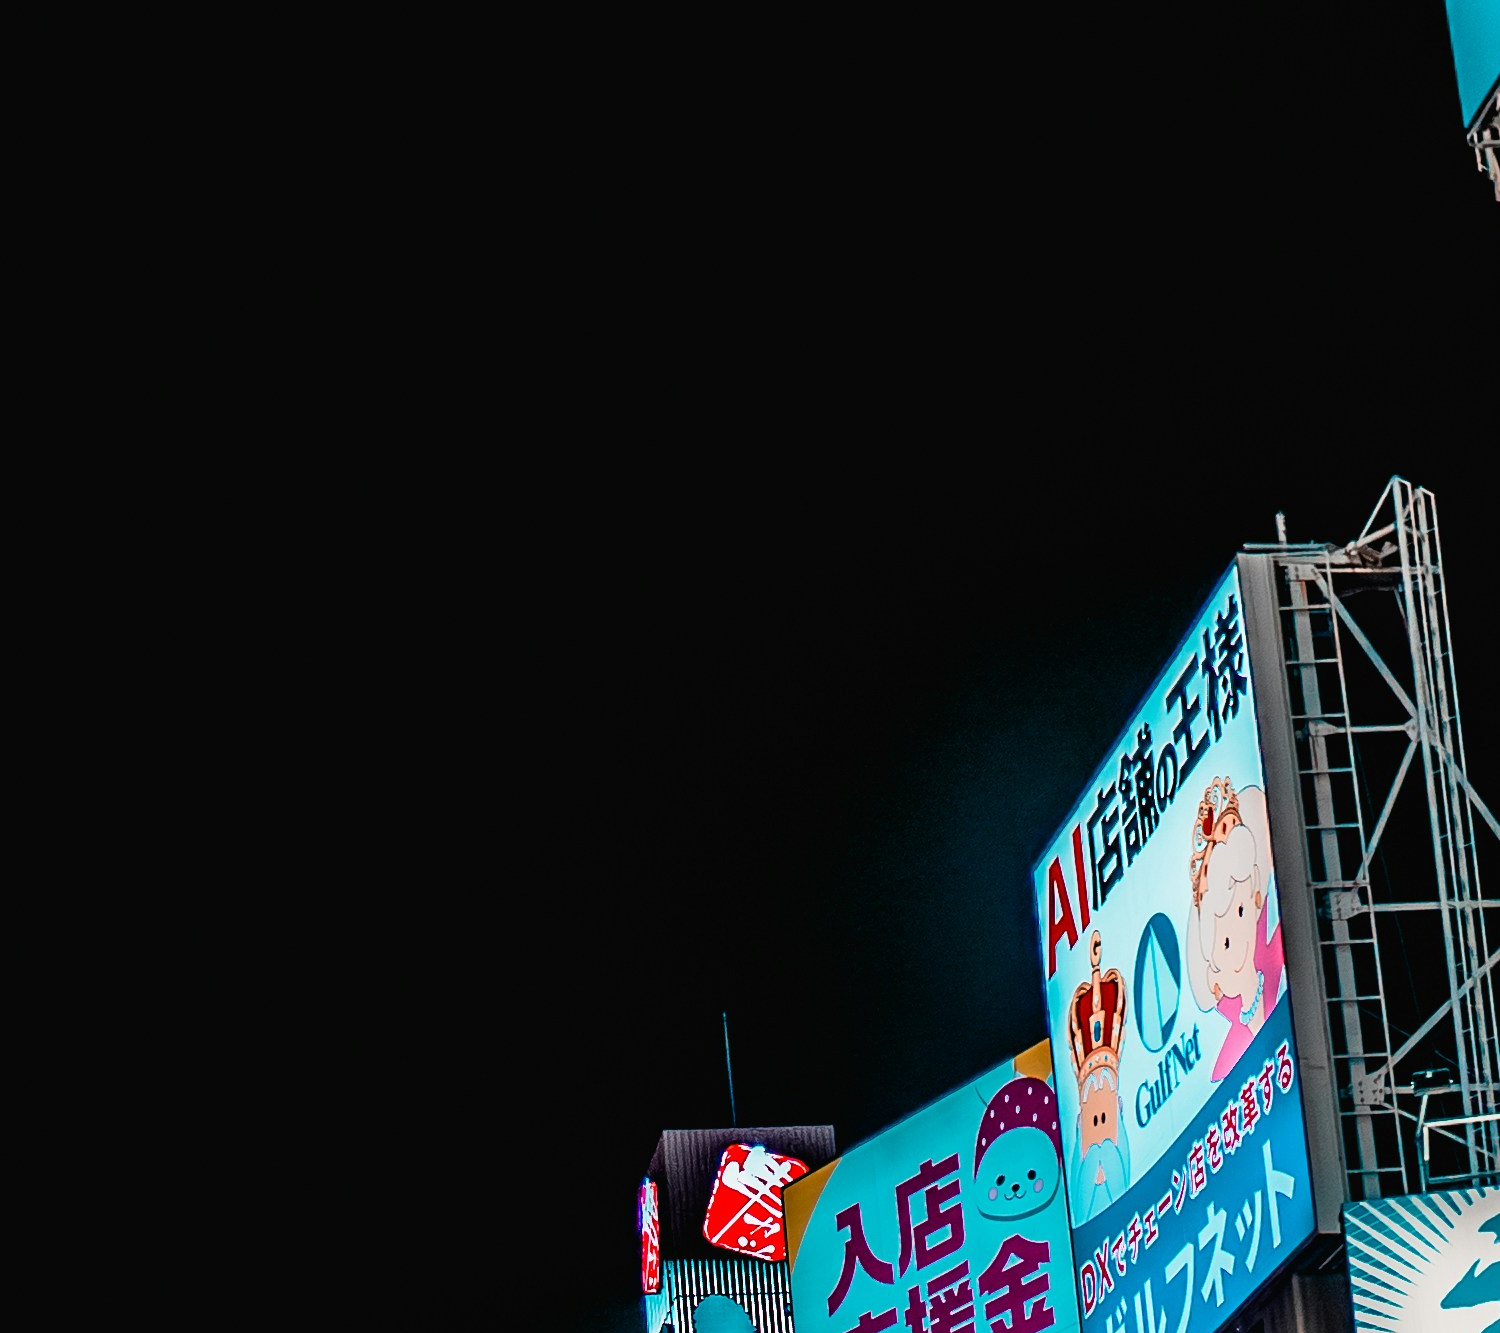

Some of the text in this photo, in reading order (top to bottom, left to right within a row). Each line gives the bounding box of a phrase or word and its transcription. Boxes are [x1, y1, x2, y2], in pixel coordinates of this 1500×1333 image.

[1045, 593, 1250, 981] AI店舗の王様
[826, 1153, 965, 1318] 入店
[1081, 1044, 1295, 1318] DXでチェーン店を改革する
